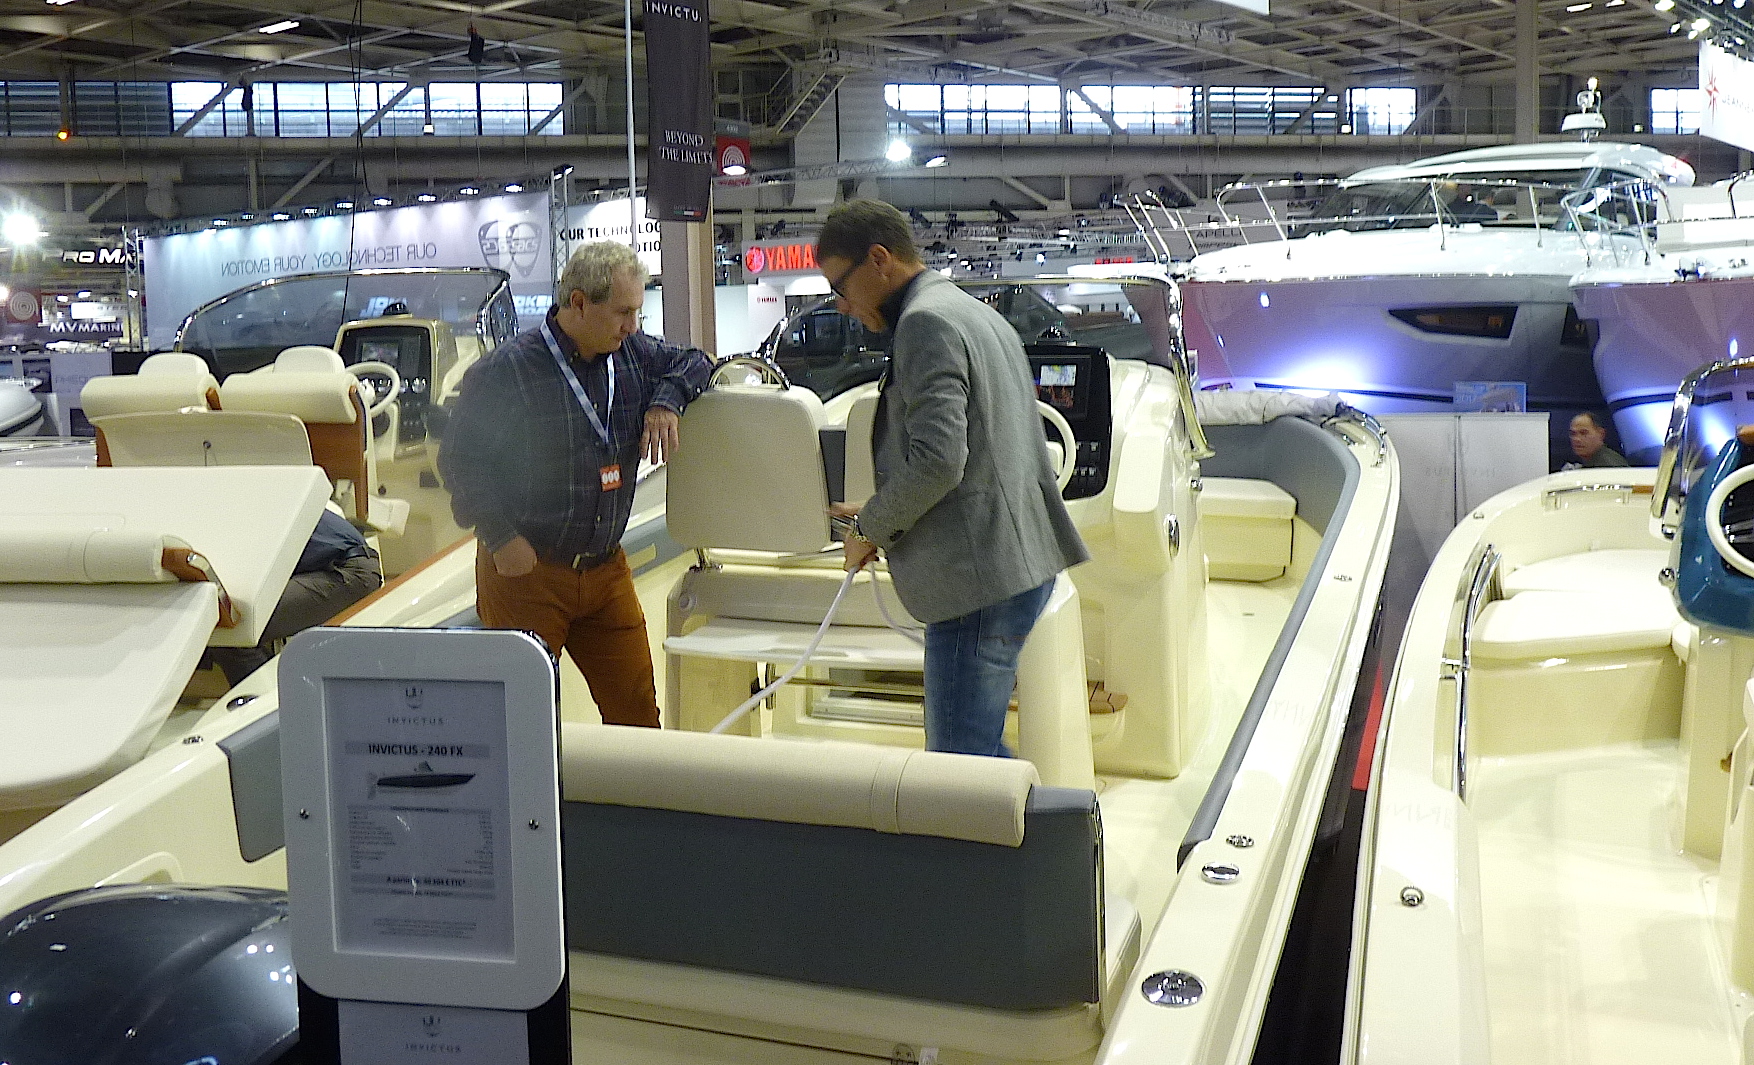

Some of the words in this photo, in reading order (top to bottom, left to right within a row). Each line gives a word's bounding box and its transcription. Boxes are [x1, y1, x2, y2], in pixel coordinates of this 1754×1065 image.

[645, 1, 702, 23] INVICTU
[664, 129, 704, 147] BEYOND
[659, 145, 680, 162] THE
[388, 717, 444, 726] INVICTUS
[369, 743, 417, 756] INVICTUS
[428, 745, 448, 756] 240
[451, 746, 463, 756] FX
[405, 1042, 461, 1053] INVICTUS
